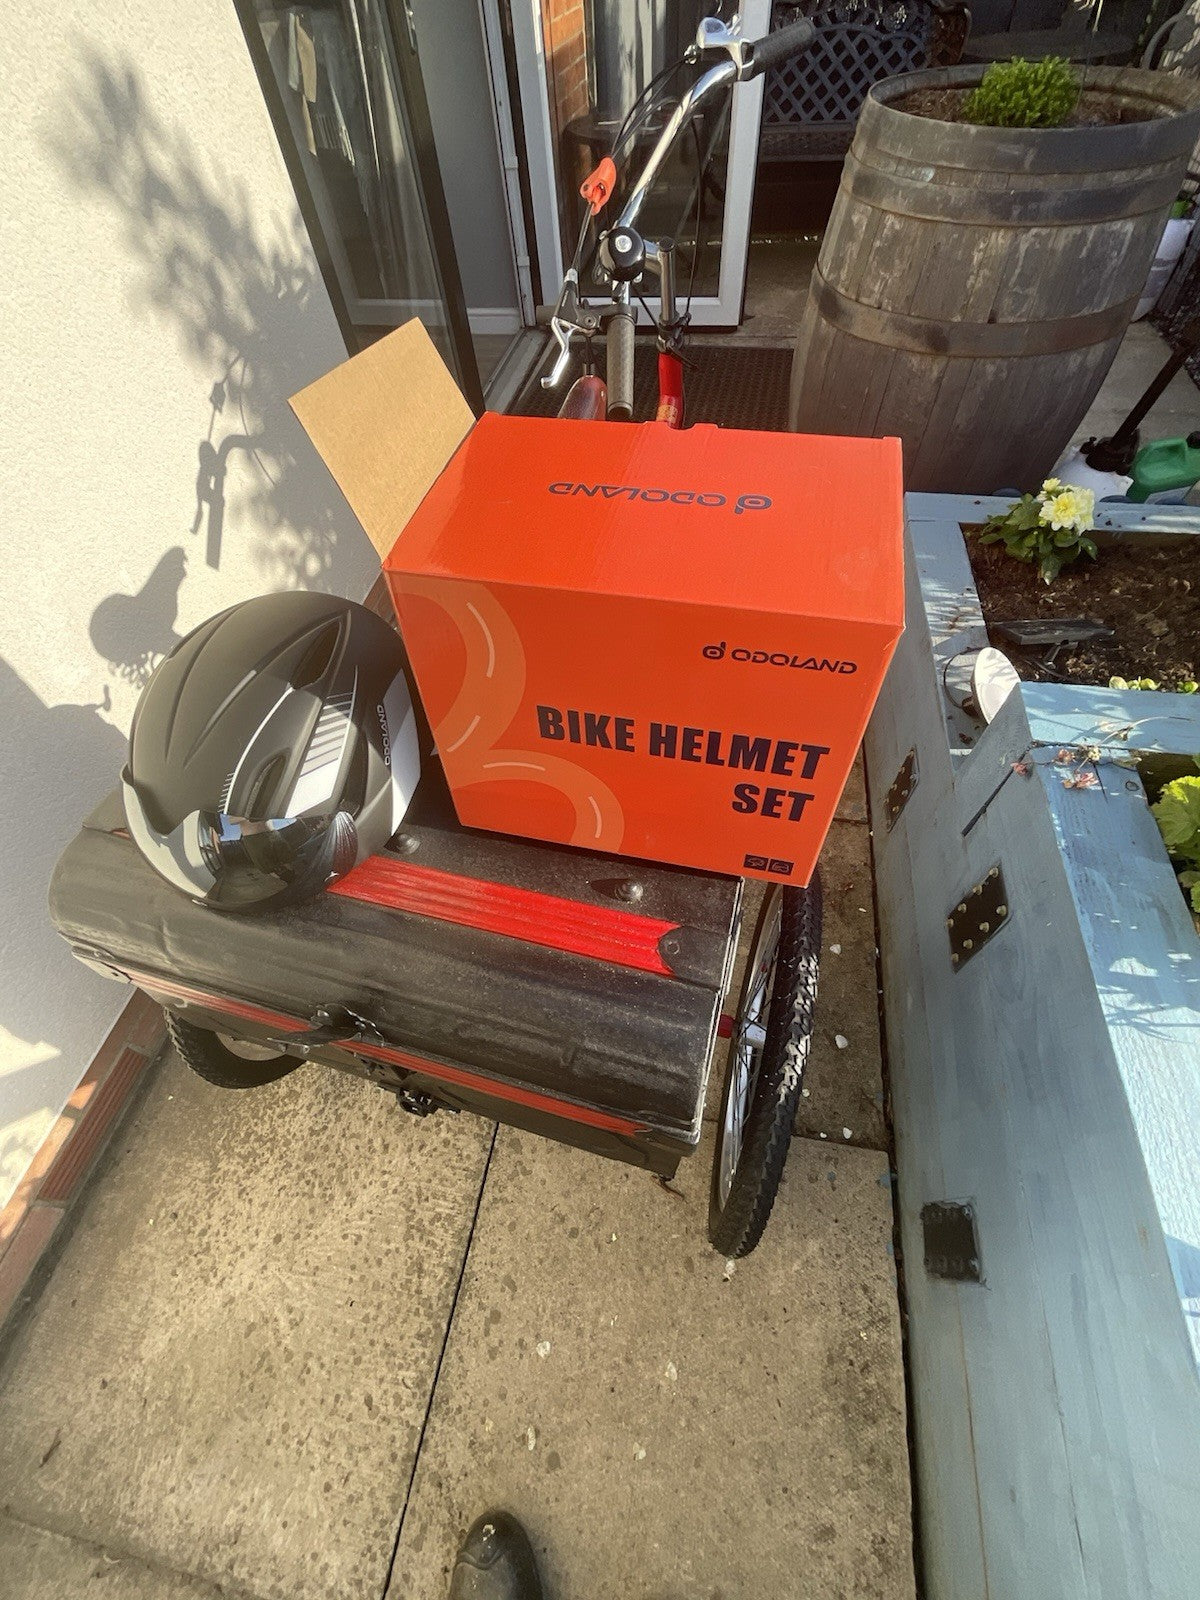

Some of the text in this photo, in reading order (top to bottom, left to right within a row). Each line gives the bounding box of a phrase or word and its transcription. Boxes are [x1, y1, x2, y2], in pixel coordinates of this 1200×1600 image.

[548, 481, 727, 508] ODOLAND
[730, 648, 859, 675] ODOLAND
[376, 704, 391, 766] ODOLAND
[536, 704, 831, 780] BIKE HELMET
[731, 782, 815, 823] SET
